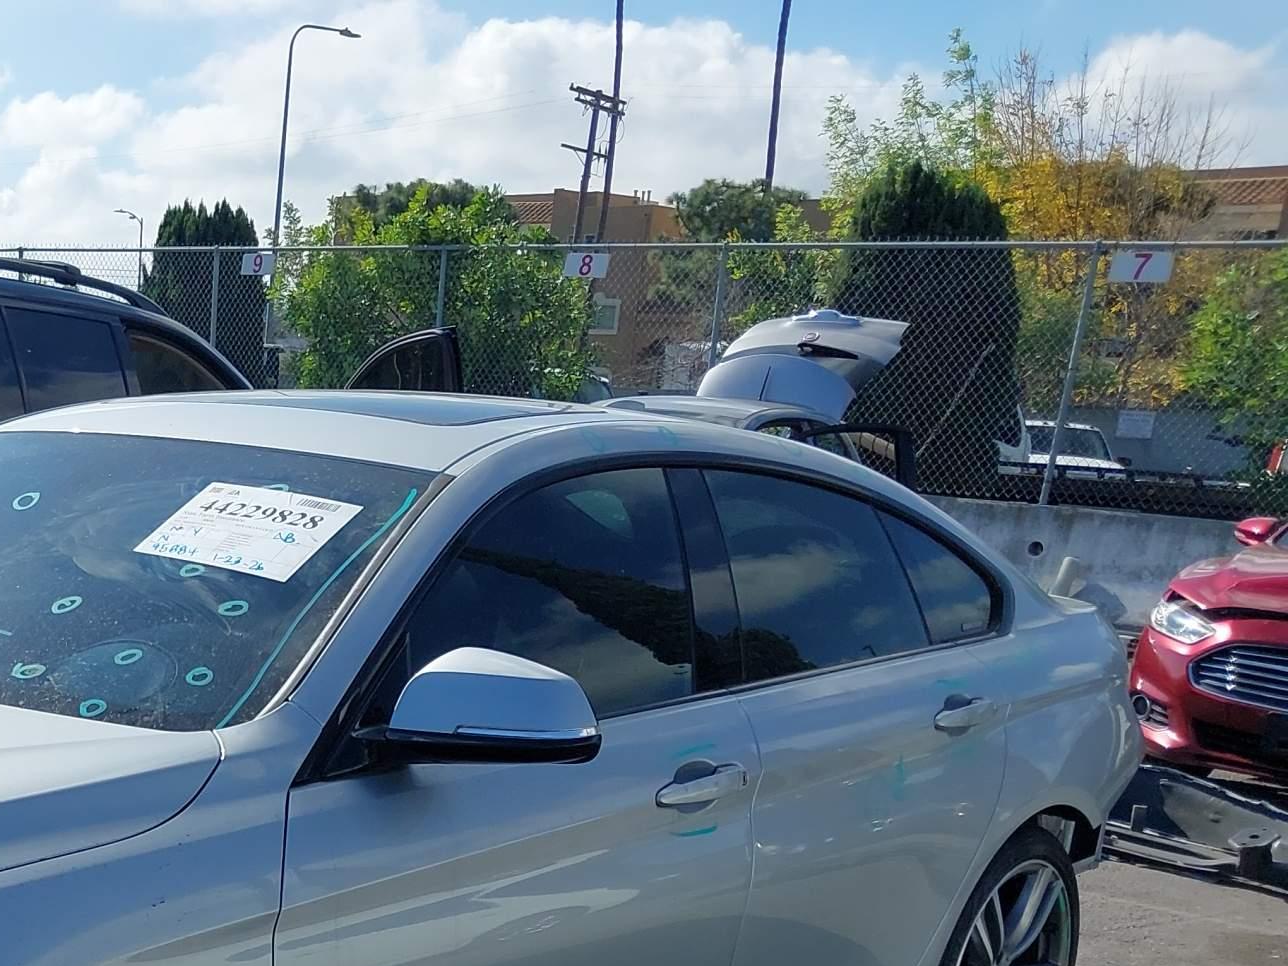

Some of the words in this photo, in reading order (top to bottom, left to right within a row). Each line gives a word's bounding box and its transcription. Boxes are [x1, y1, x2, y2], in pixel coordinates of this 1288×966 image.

[252, 254, 263, 274] 9
[578, 254, 593, 276] 8
[1133, 252, 1153, 280] 7
[198, 499, 325, 530] 44229828
